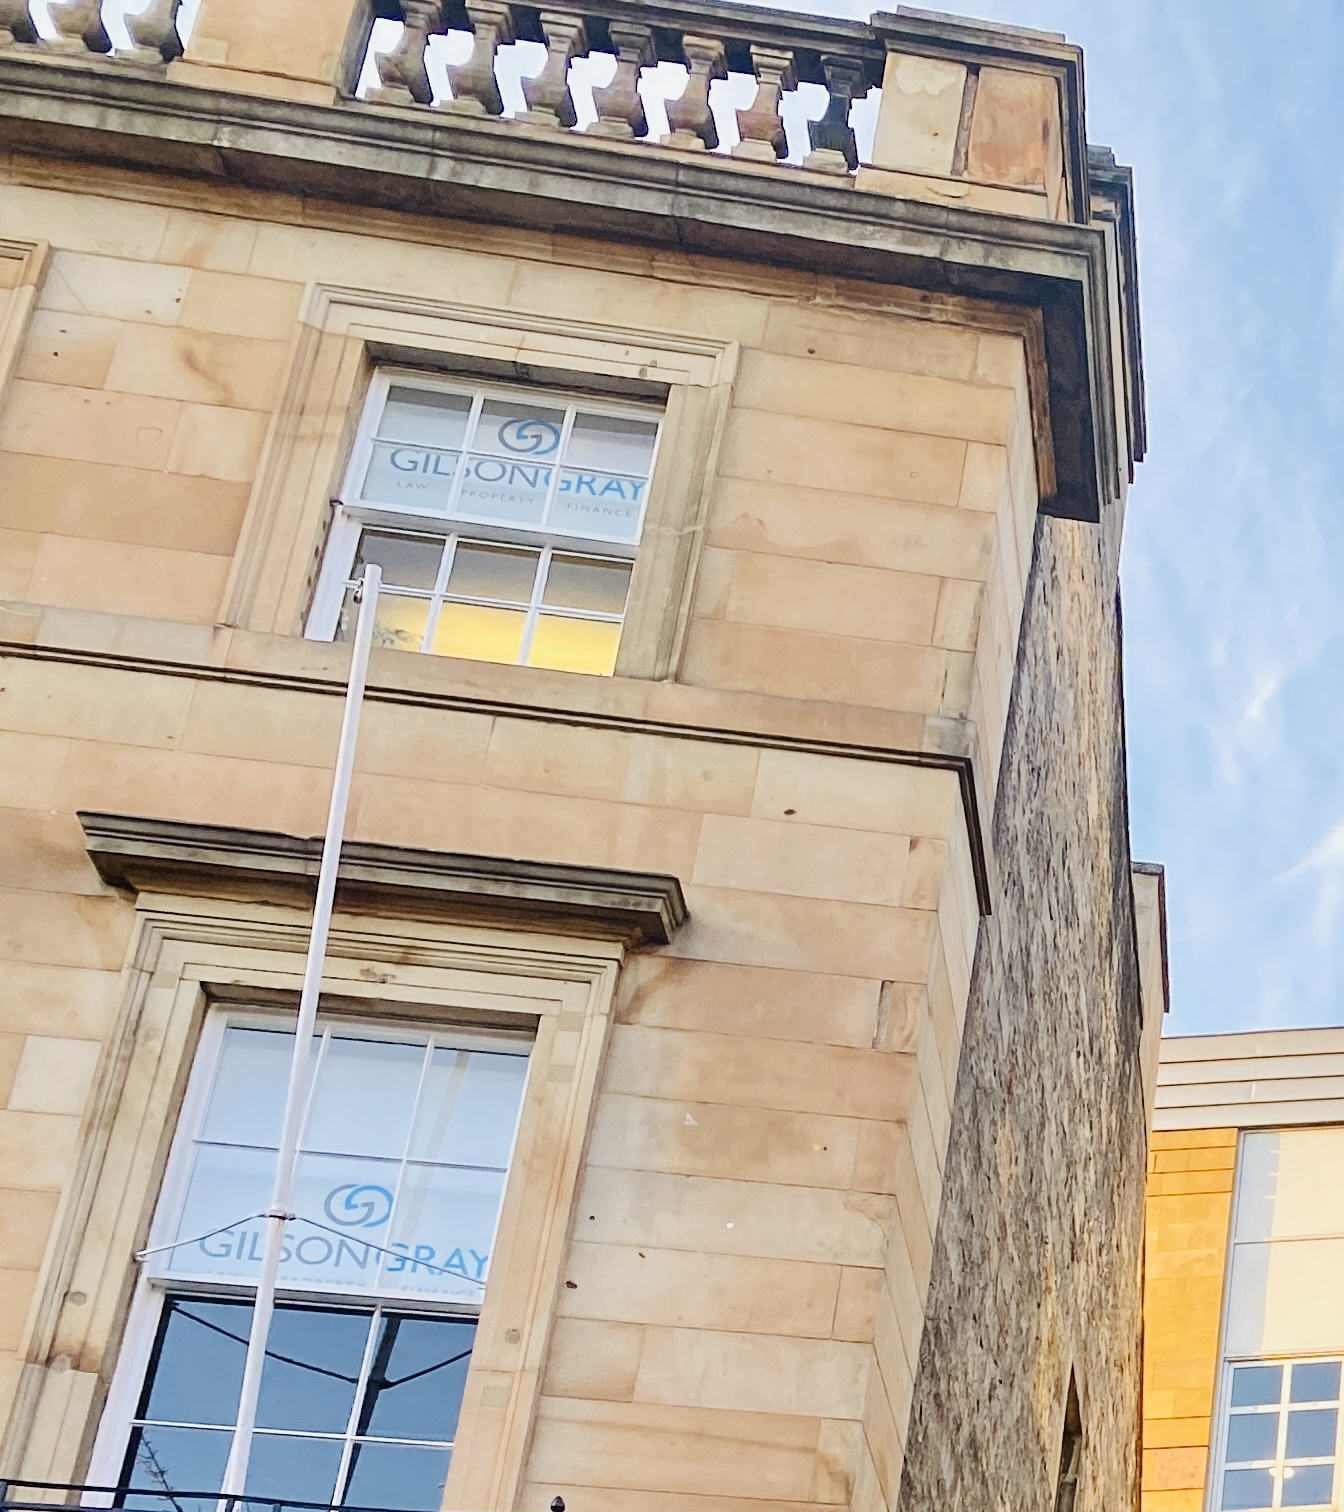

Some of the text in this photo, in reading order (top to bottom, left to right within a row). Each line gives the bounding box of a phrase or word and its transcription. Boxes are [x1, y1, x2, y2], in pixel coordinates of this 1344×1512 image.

[396, 480, 633, 519] LAW PROPERTY FINANCE
[200, 1229, 488, 1280] GILSONGRAY
